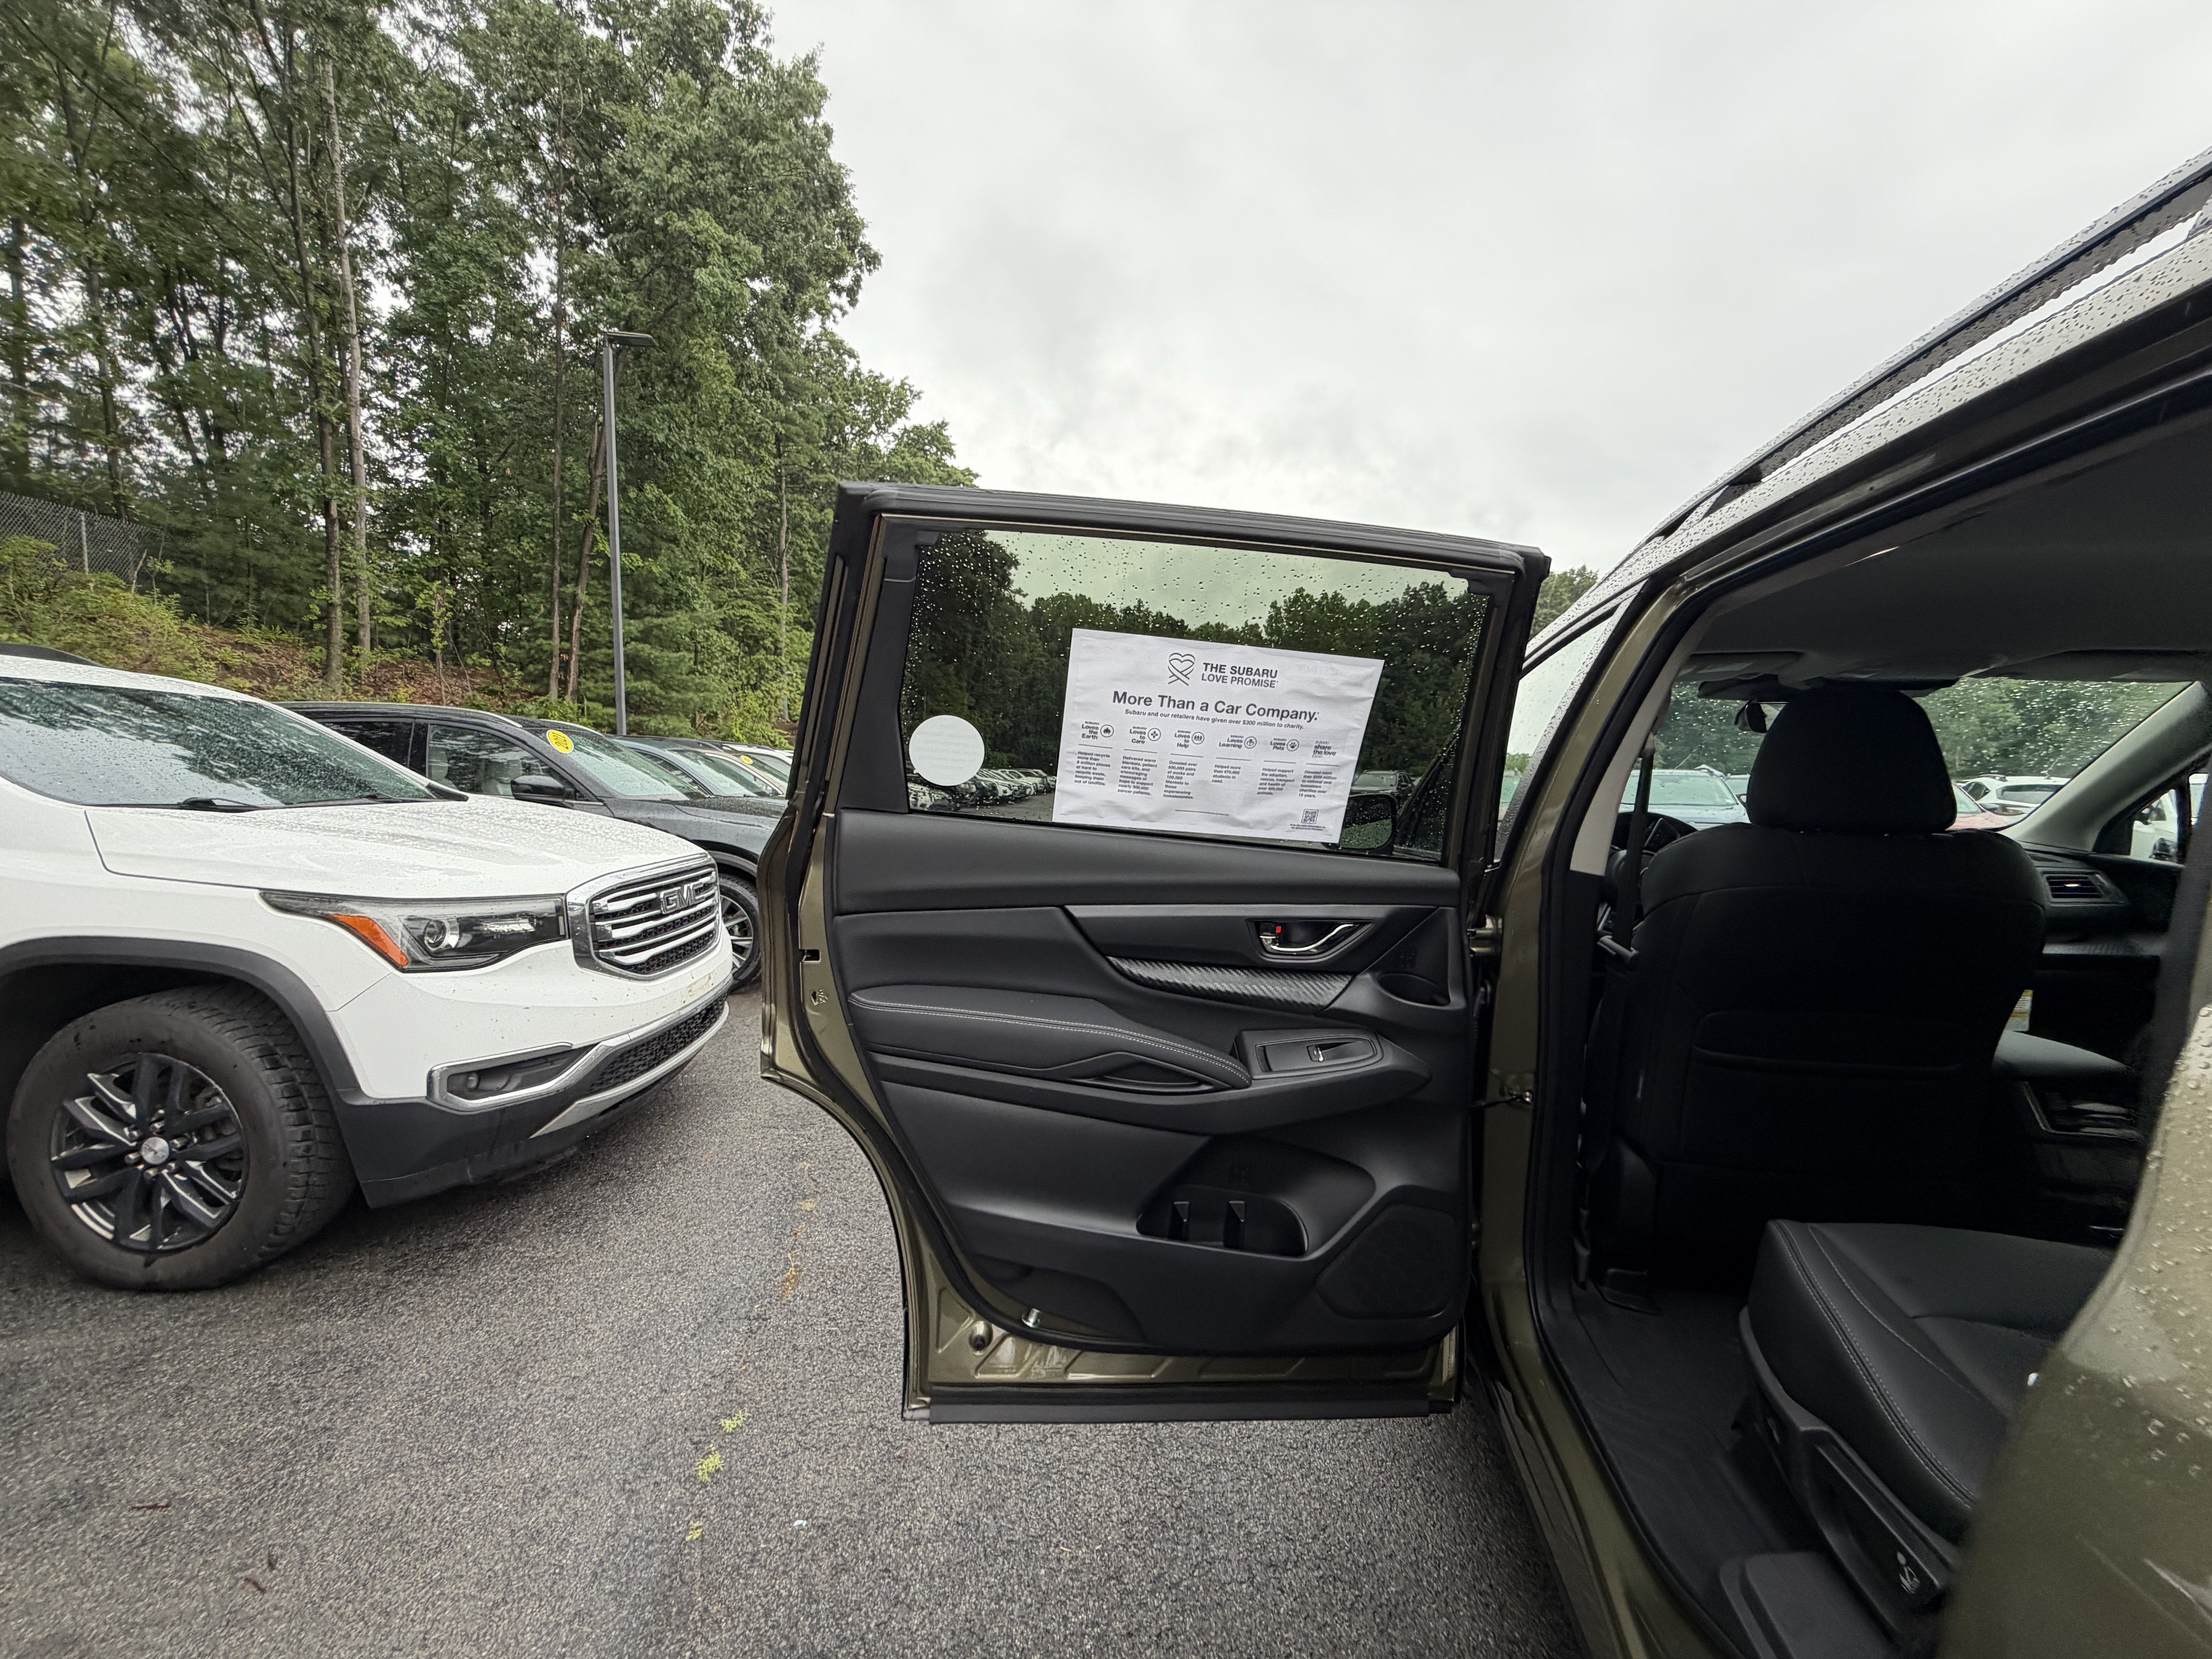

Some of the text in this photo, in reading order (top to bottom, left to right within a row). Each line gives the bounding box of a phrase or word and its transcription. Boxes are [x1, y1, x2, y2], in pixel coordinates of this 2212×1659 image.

[1202, 673, 1228, 683] LOVE
[1203, 663, 1278, 678] THE SUBARU
[1113, 691, 1152, 706] More
[1158, 695, 1195, 710] Than
[1200, 702, 1209, 711] a
[1214, 701, 1242, 714] Car
[660, 882, 705, 914] GMC
